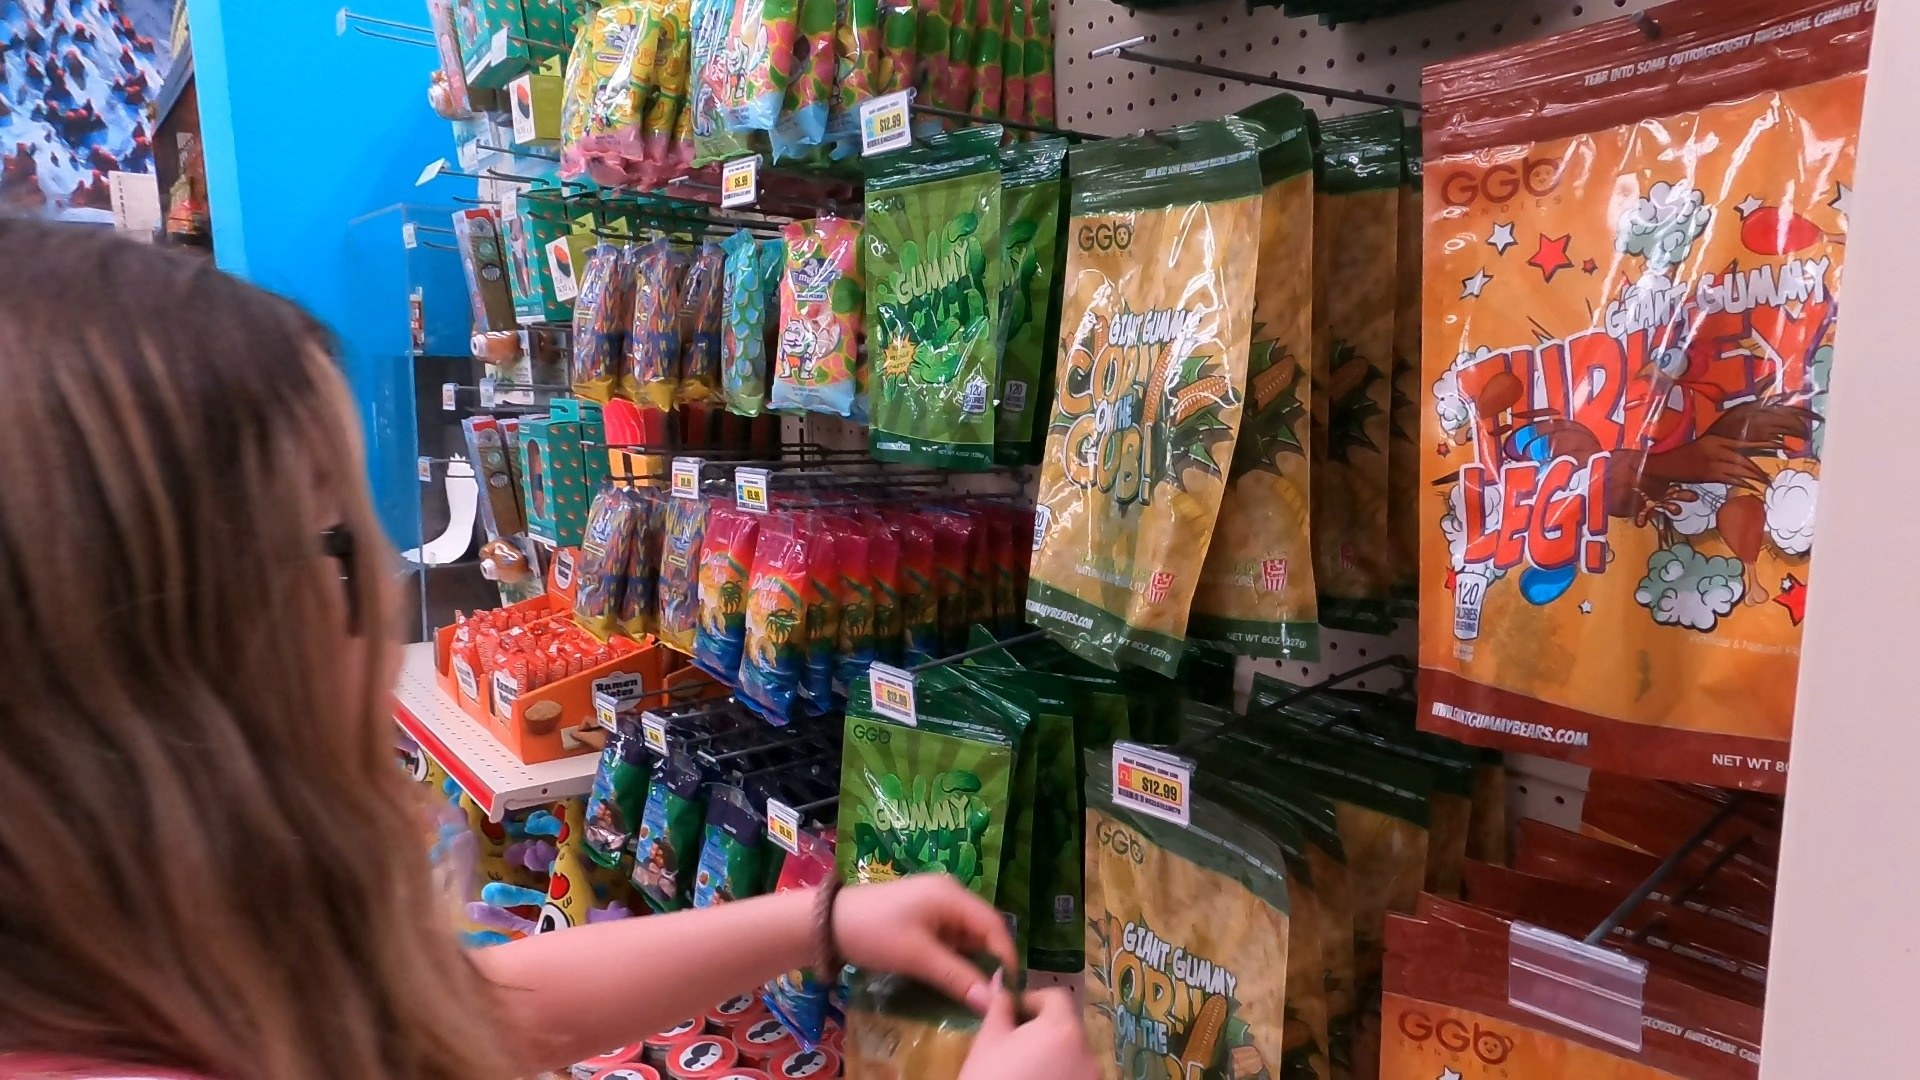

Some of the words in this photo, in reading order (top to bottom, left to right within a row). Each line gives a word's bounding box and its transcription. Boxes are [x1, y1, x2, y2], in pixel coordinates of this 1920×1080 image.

[1584, 70, 1609, 87] TEAR
[1610, 64, 1635, 82] INTO
[1636, 55, 1668, 75] SOME
[1668, 33, 1751, 67] OUTRAGEOUSLY
[879, 112, 902, 133] $12.99
[895, 238, 970, 305] GUMMY
[1606, 284, 1688, 338] GIANT
[1695, 256, 1831, 314] GUMMY
[968, 383, 983, 397] 120
[1456, 293, 1837, 480] TURKEY
[1459, 450, 1612, 575] LEG!
[1457, 580, 1480, 606] 120
[1245, 634, 1260, 643] WT
[595, 679, 638, 692] Ramen
[1431, 701, 1589, 746] WWW.GIANTGUMMYBEARS.COM
[1712, 753, 1744, 767] NET
[1746, 756, 1772, 771] WT
[1141, 776, 1178, 802] $12.99
[873, 794, 970, 832] GUMMY
[1123, 921, 1171, 972] GIANT
[1172, 947, 1238, 997] GUMMY
[1116, 1004, 1137, 1044] ON
[1140, 1017, 1169, 1056] THE
